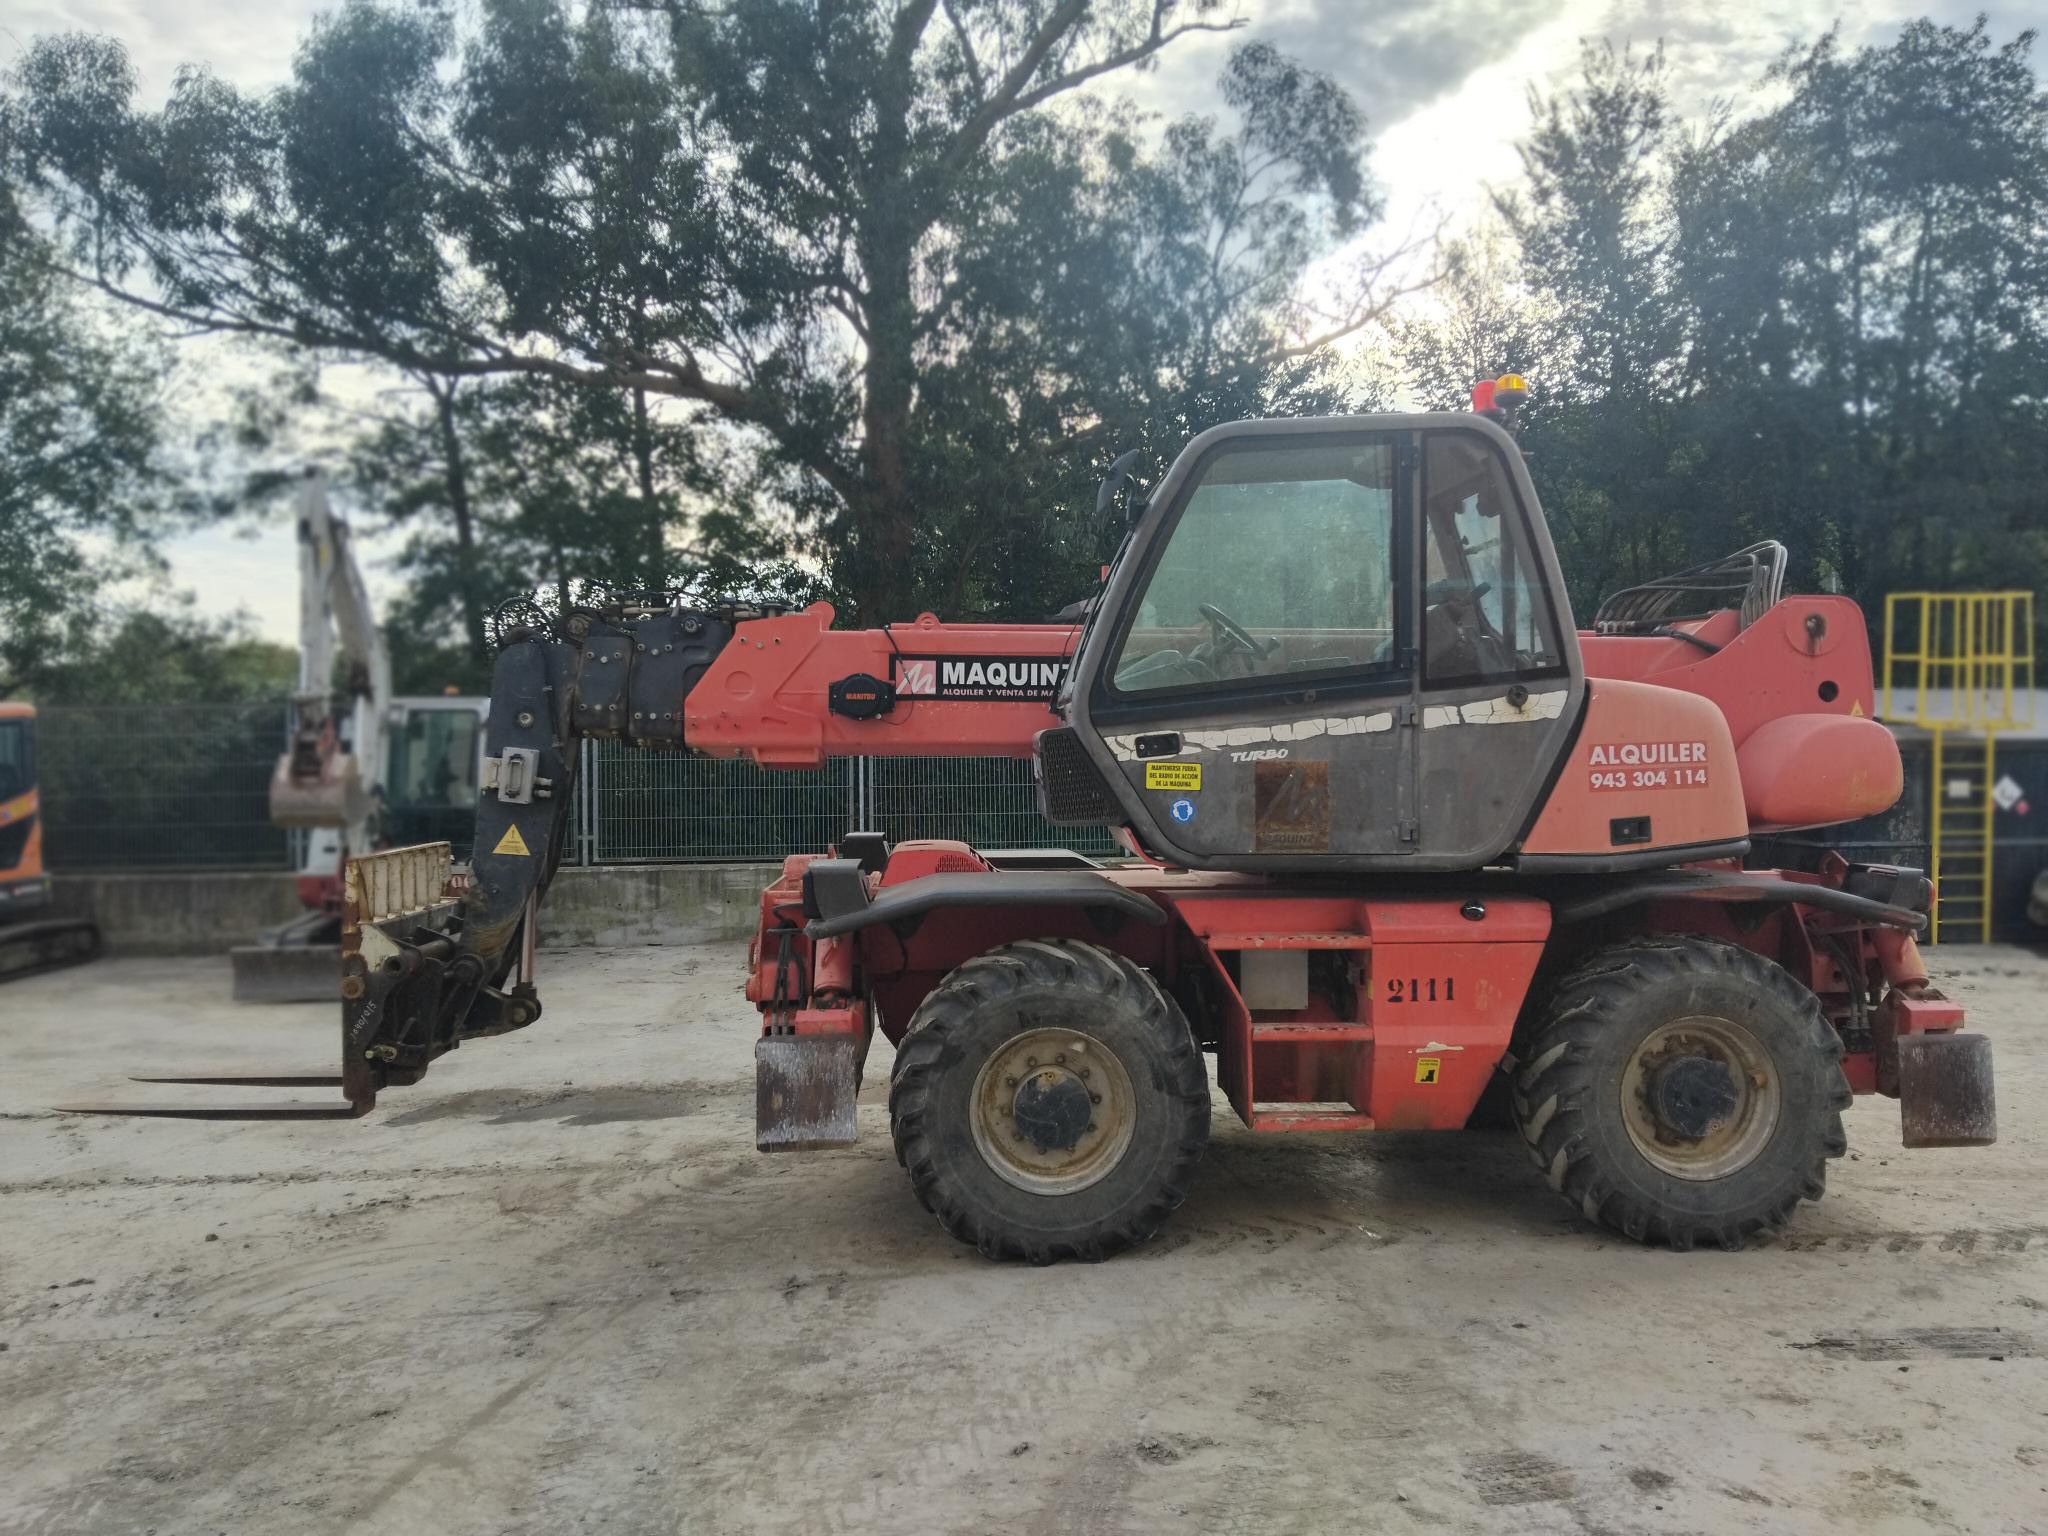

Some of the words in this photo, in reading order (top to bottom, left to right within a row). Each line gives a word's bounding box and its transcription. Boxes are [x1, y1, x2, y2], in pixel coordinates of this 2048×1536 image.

[996, 689, 1024, 697] VENTA
[1027, 689, 1038, 697] DE
[1230, 749, 1288, 762] TURBO
[1589, 742, 1707, 765] ALQUILER
[1590, 772, 1626, 789] 943
[1632, 771, 1667, 787] 304
[1674, 769, 1707, 785] 114
[1387, 977, 1455, 1003] 2111
